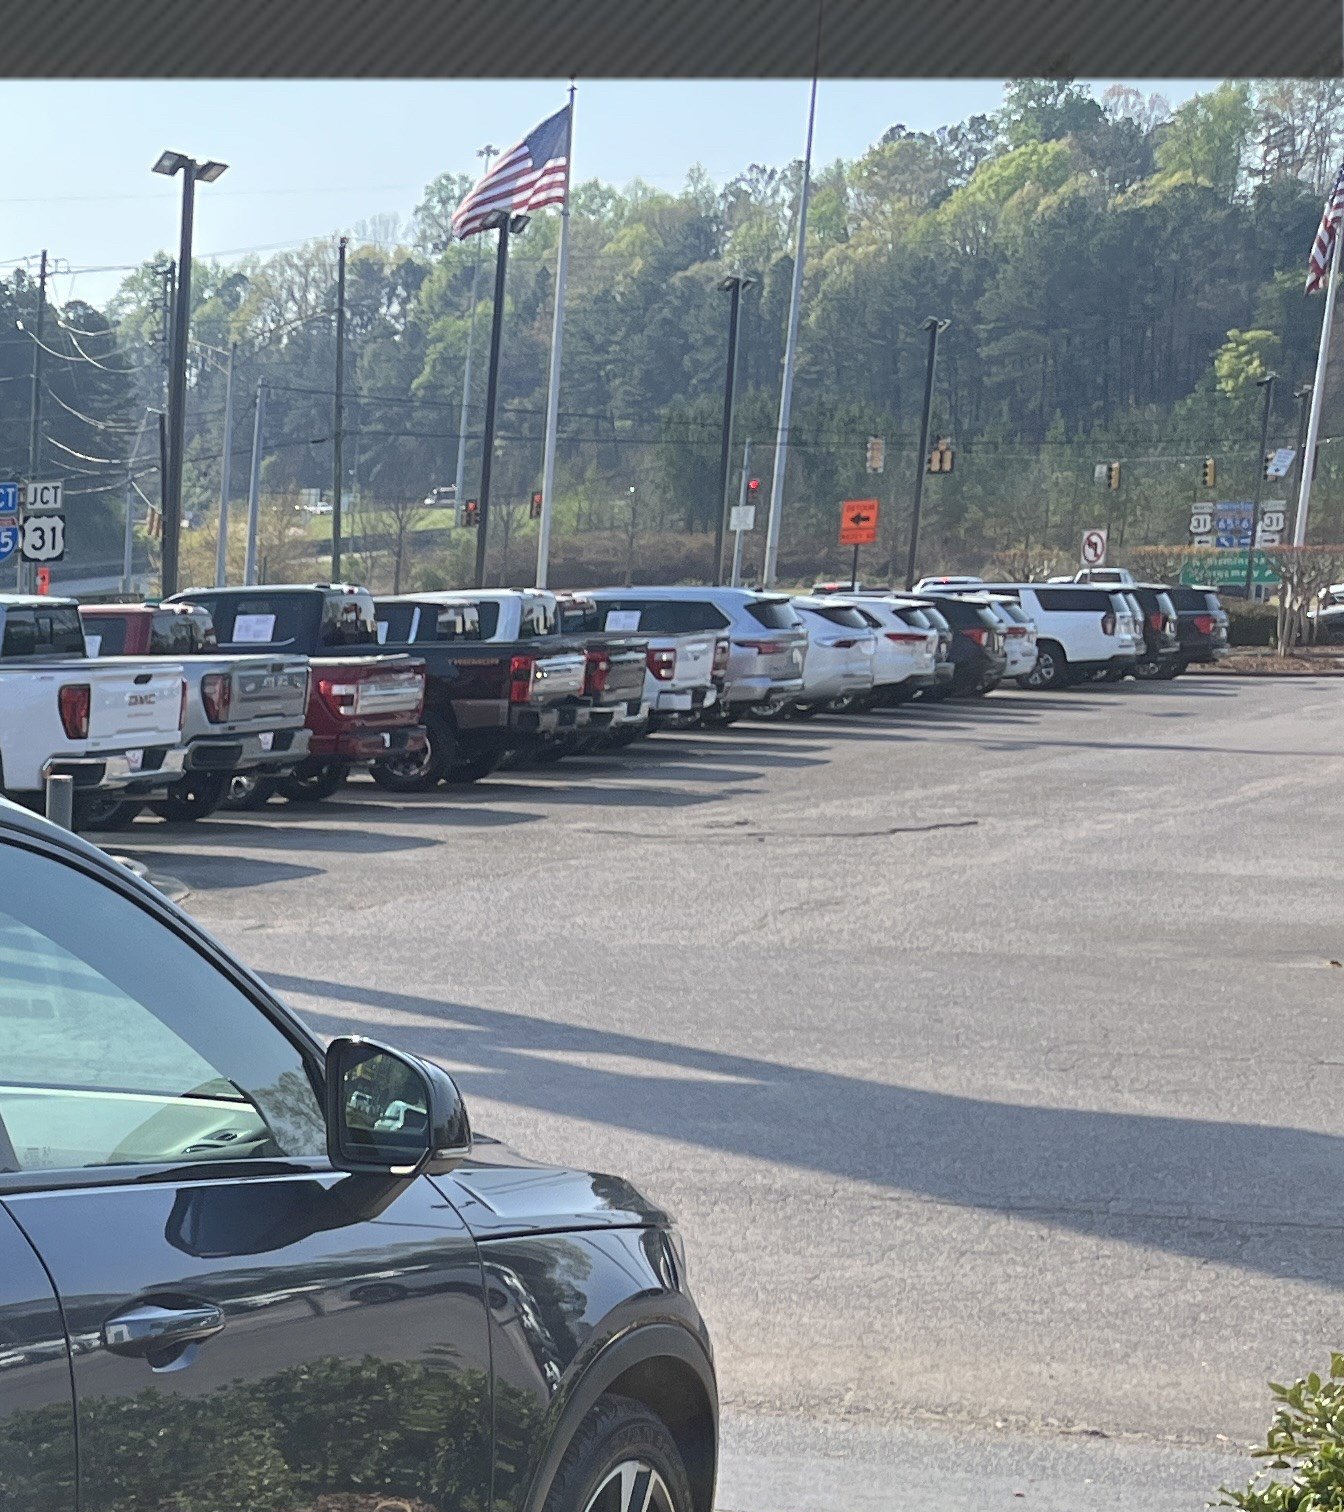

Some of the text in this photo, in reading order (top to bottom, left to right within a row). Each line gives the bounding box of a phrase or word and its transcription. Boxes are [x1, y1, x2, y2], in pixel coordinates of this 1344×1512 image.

[29, 485, 60, 506] JCT
[1193, 517, 1207, 529] 31
[1265, 516, 1280, 528] 31
[31, 526, 56, 551] 31
